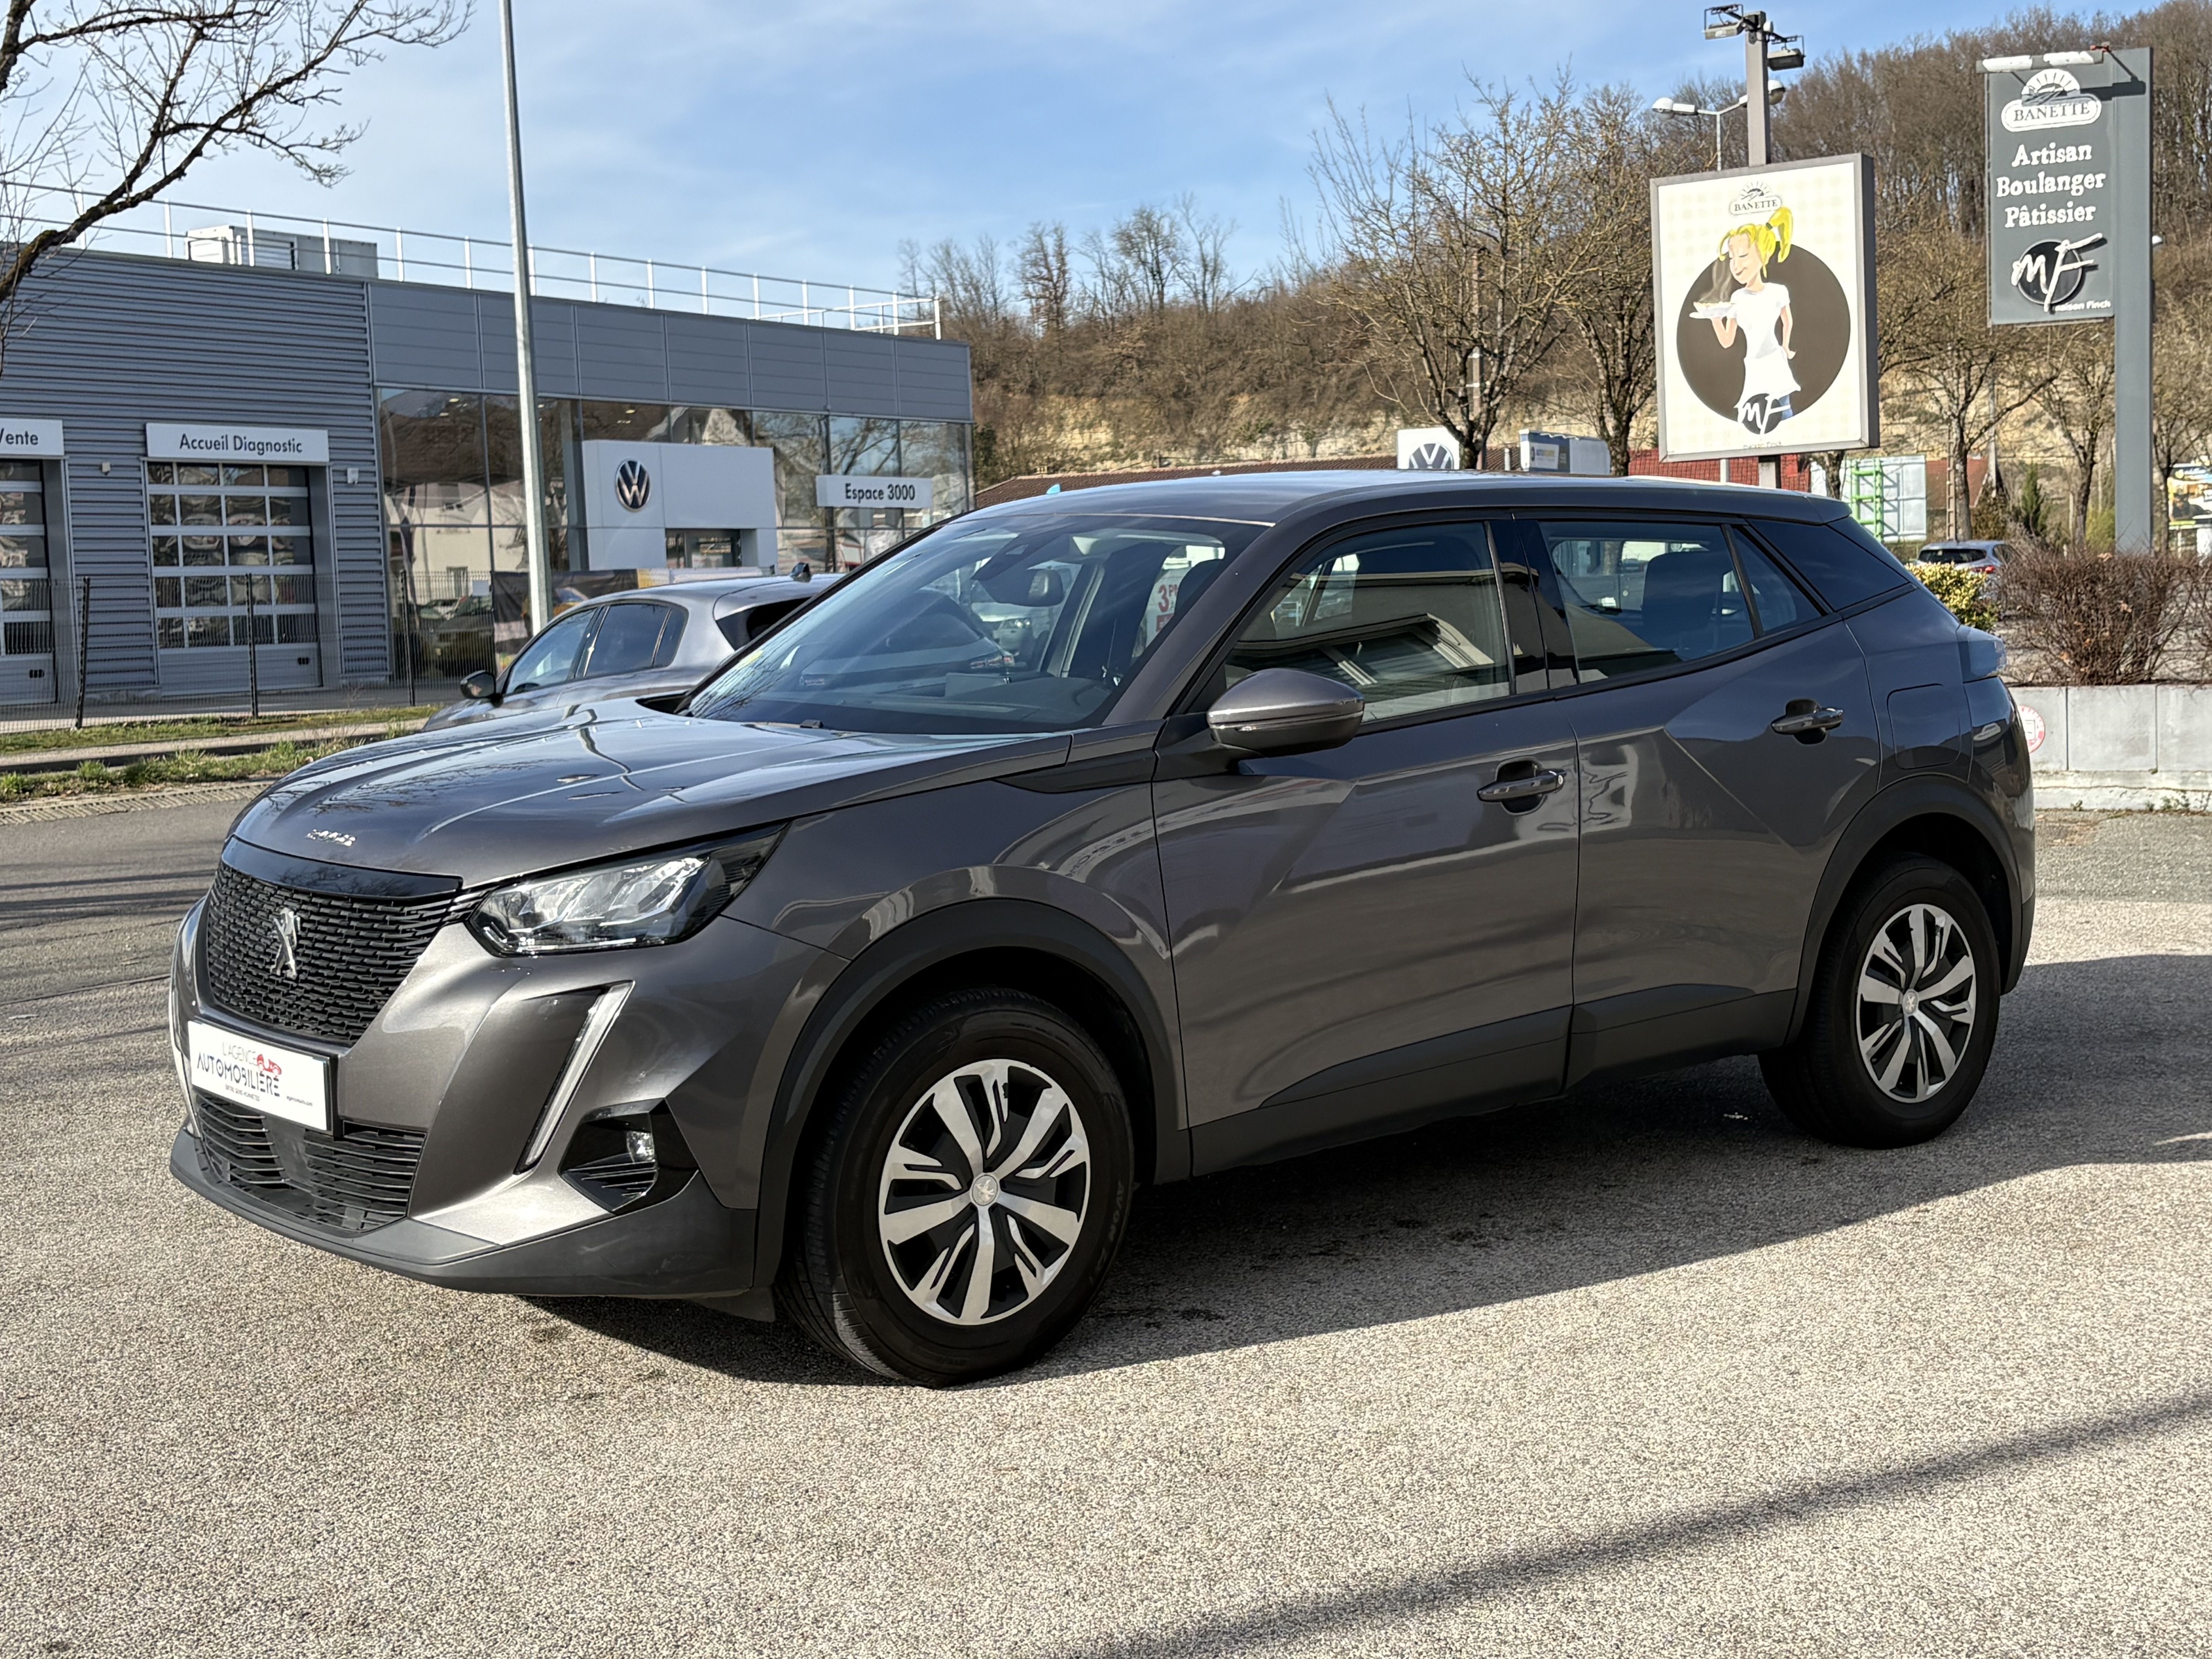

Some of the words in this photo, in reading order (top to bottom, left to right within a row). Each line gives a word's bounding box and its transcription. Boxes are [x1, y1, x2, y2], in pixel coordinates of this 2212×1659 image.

[2013, 101, 2091, 122] BANETTE
[2011, 142, 2092, 168] Artisan
[1996, 171, 2106, 198] Boulanger
[1734, 199, 1778, 212] BANETTE
[2004, 201, 2097, 228] Pâtissier
[179, 433, 228, 450] Accueil
[233, 434, 302, 456] Diagnostic
[845, 483, 884, 503] Espace
[888, 483, 915, 500] 3000
